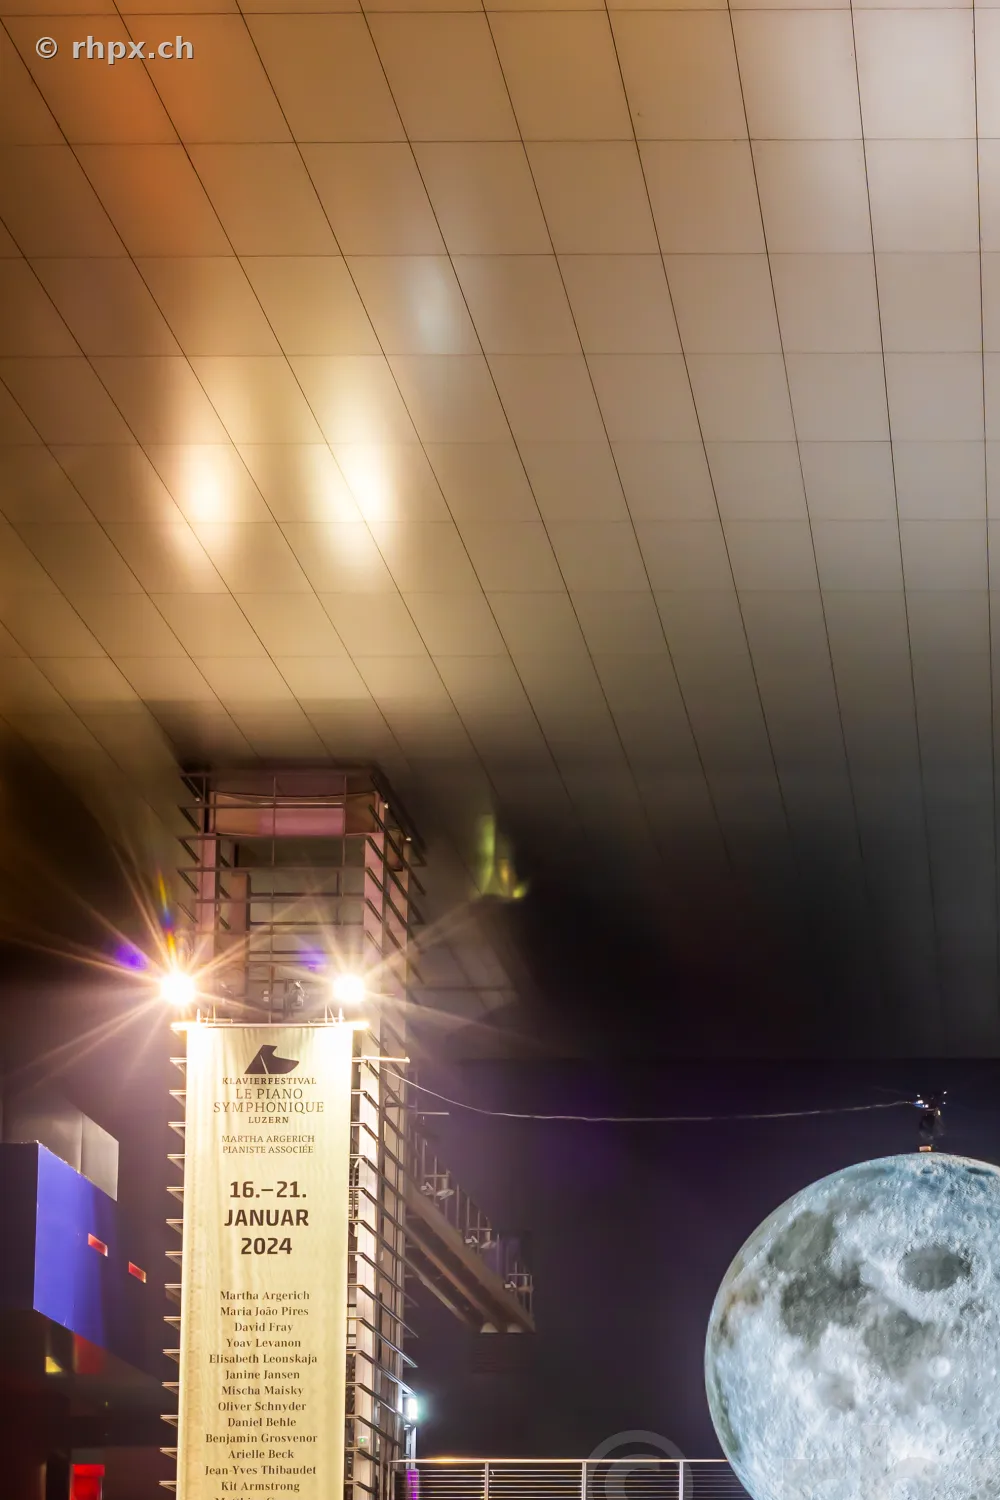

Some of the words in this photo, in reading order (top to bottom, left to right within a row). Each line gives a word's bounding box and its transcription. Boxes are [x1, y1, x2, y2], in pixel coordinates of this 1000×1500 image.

[222, 1077, 317, 1085] KLAVIERFESTIVAL
[236, 1088, 252, 1099] LE
[256, 1088, 304, 1099] PIANO
[213, 1101, 325, 1115] SYMPHONIQUE
[248, 1116, 290, 1124] LUZERN
[221, 1134, 264, 1143] MARTHA
[266, 1134, 315, 1143] ARGERICH
[222, 1145, 266, 1154] PIANISTE
[268, 1143, 314, 1154] ASSOCIÉE
[224, 1209, 309, 1227] JANUAR
[240, 1237, 293, 1255] 2024
[220, 1290, 259, 1301] Martha
[262, 1290, 310, 1302] Argerich
[220, 1307, 252, 1317] Maria
[255, 1307, 278, 1317] João
[281, 1307, 309, 1317] Pires
[234, 1322, 266, 1332] David
[269, 1322, 294, 1333] Fray
[226, 1338, 252, 1348] Yoav
[255, 1338, 301, 1348] Levanon
[209, 1354, 259, 1364] Elisabeth
[262, 1354, 318, 1366] Leonskaja
[225, 1370, 261, 1380] Janine
[263, 1370, 300, 1380] Jansen
[221, 1385, 260, 1396] Mischa
[264, 1385, 304, 1397] Maisky
[218, 1401, 252, 1411] Oliver
[254, 1401, 307, 1413] Schnyder
[227, 1417, 263, 1427] Daniel
[265, 1417, 297, 1427] Behle
[205, 1433, 258, 1445] Benjamin
[261, 1433, 318, 1443] Grosvenor
[228, 1449, 265, 1459] Arielle
[268, 1449, 294, 1459] Beck
[204, 1466, 258, 1476] Jean-Yves
[260, 1466, 317, 1475] Thibaudet
[221, 1482, 237, 1491] Kit
[241, 1482, 300, 1493] Armstrong
